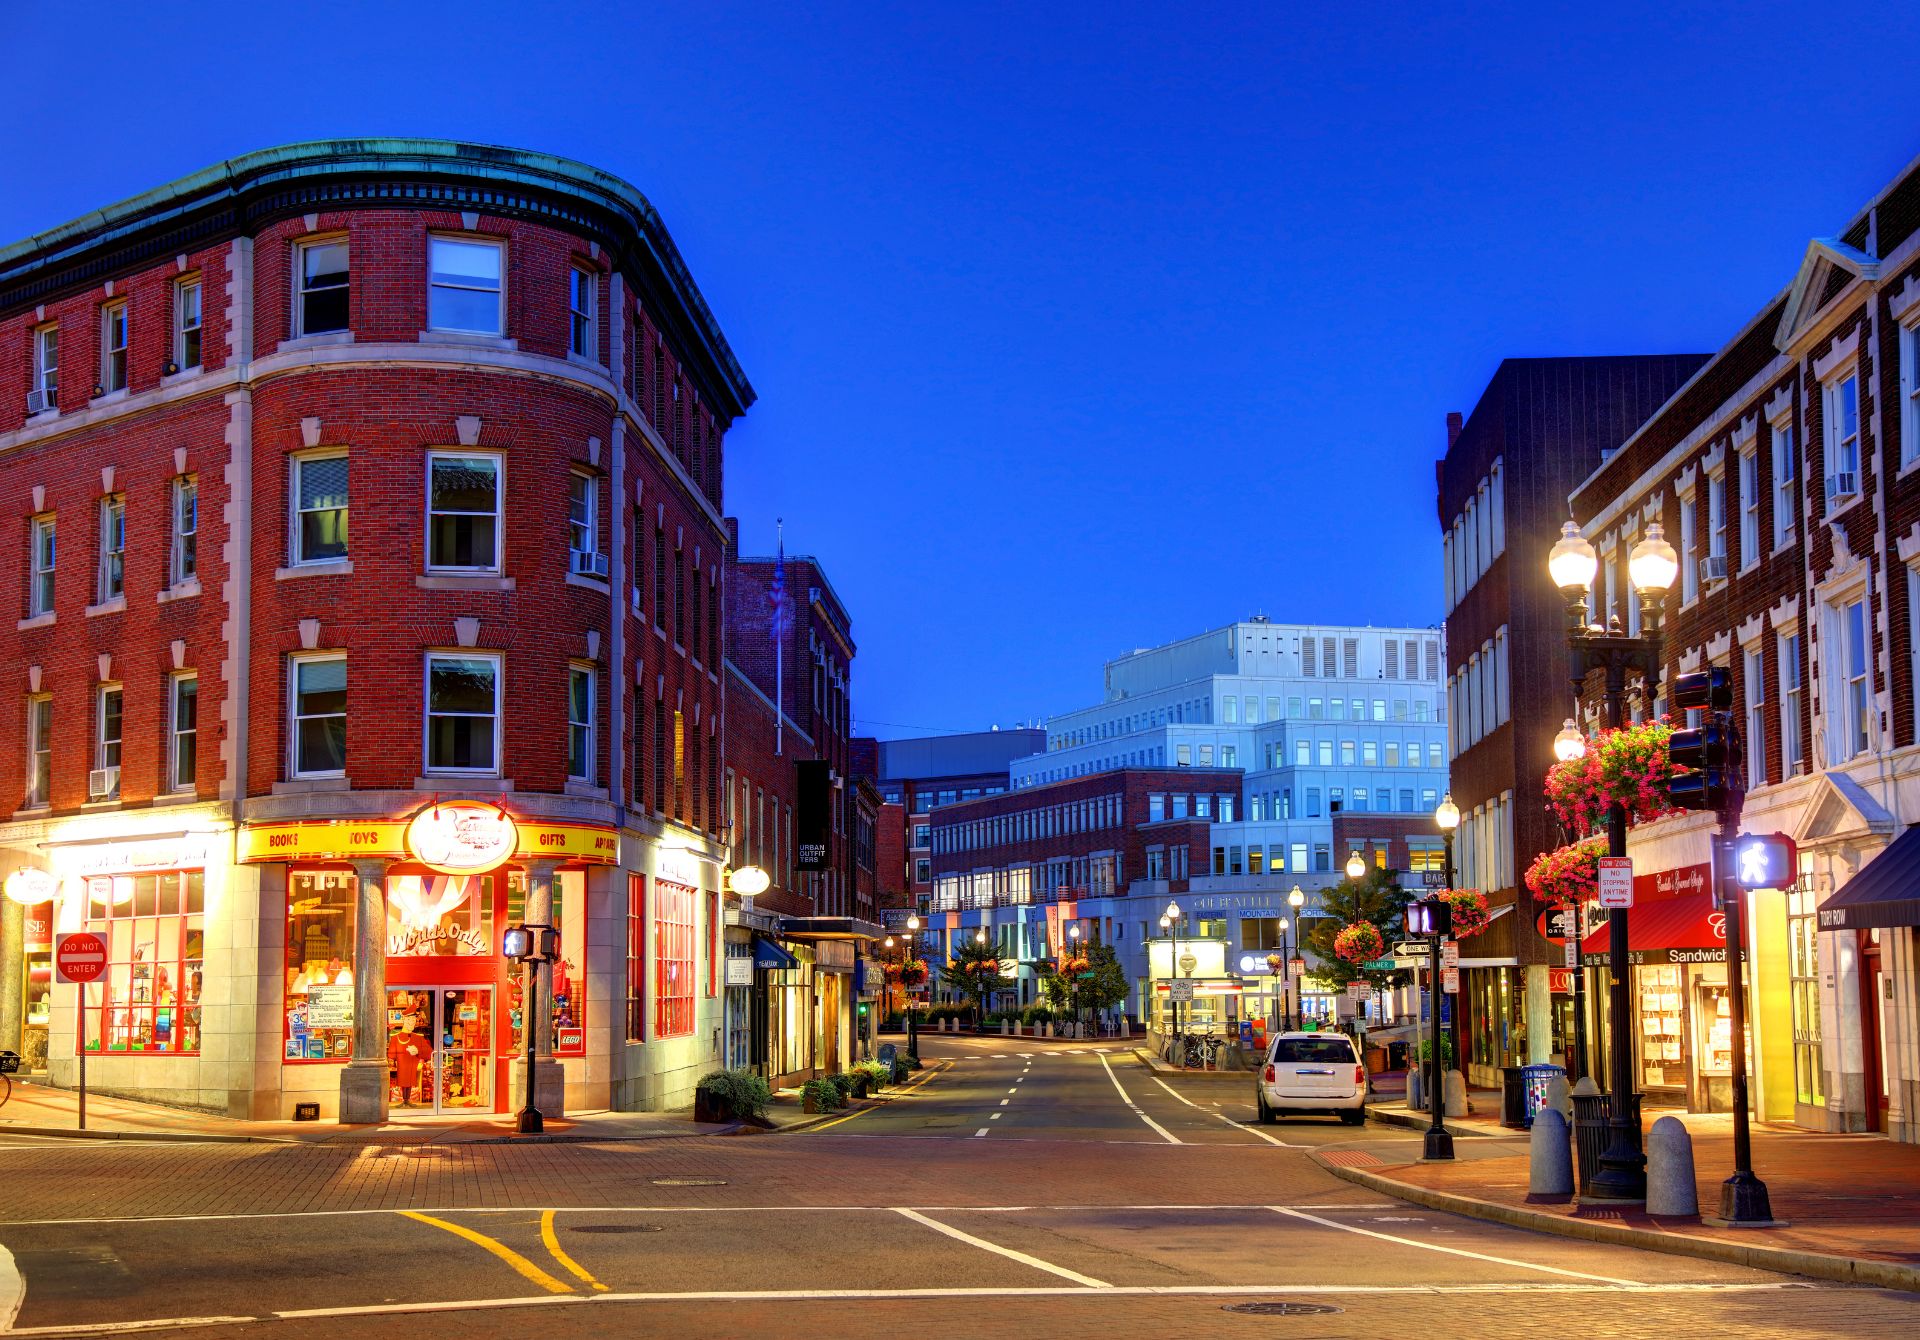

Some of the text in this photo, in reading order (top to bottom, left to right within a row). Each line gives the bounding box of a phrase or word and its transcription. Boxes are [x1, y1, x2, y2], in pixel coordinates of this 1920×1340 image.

[540, 834, 566, 846] GIFTS
[1239, 910, 1279, 918] MOUNTAIN
[1820, 908, 1846, 926] TORY ROW
[390, 922, 487, 955] World's Only
[64, 943, 100, 952] DO NOT
[1669, 948, 1745, 962] Sandwichs
[67, 964, 96, 972] ENTER
[562, 1036, 580, 1044] LEGO
